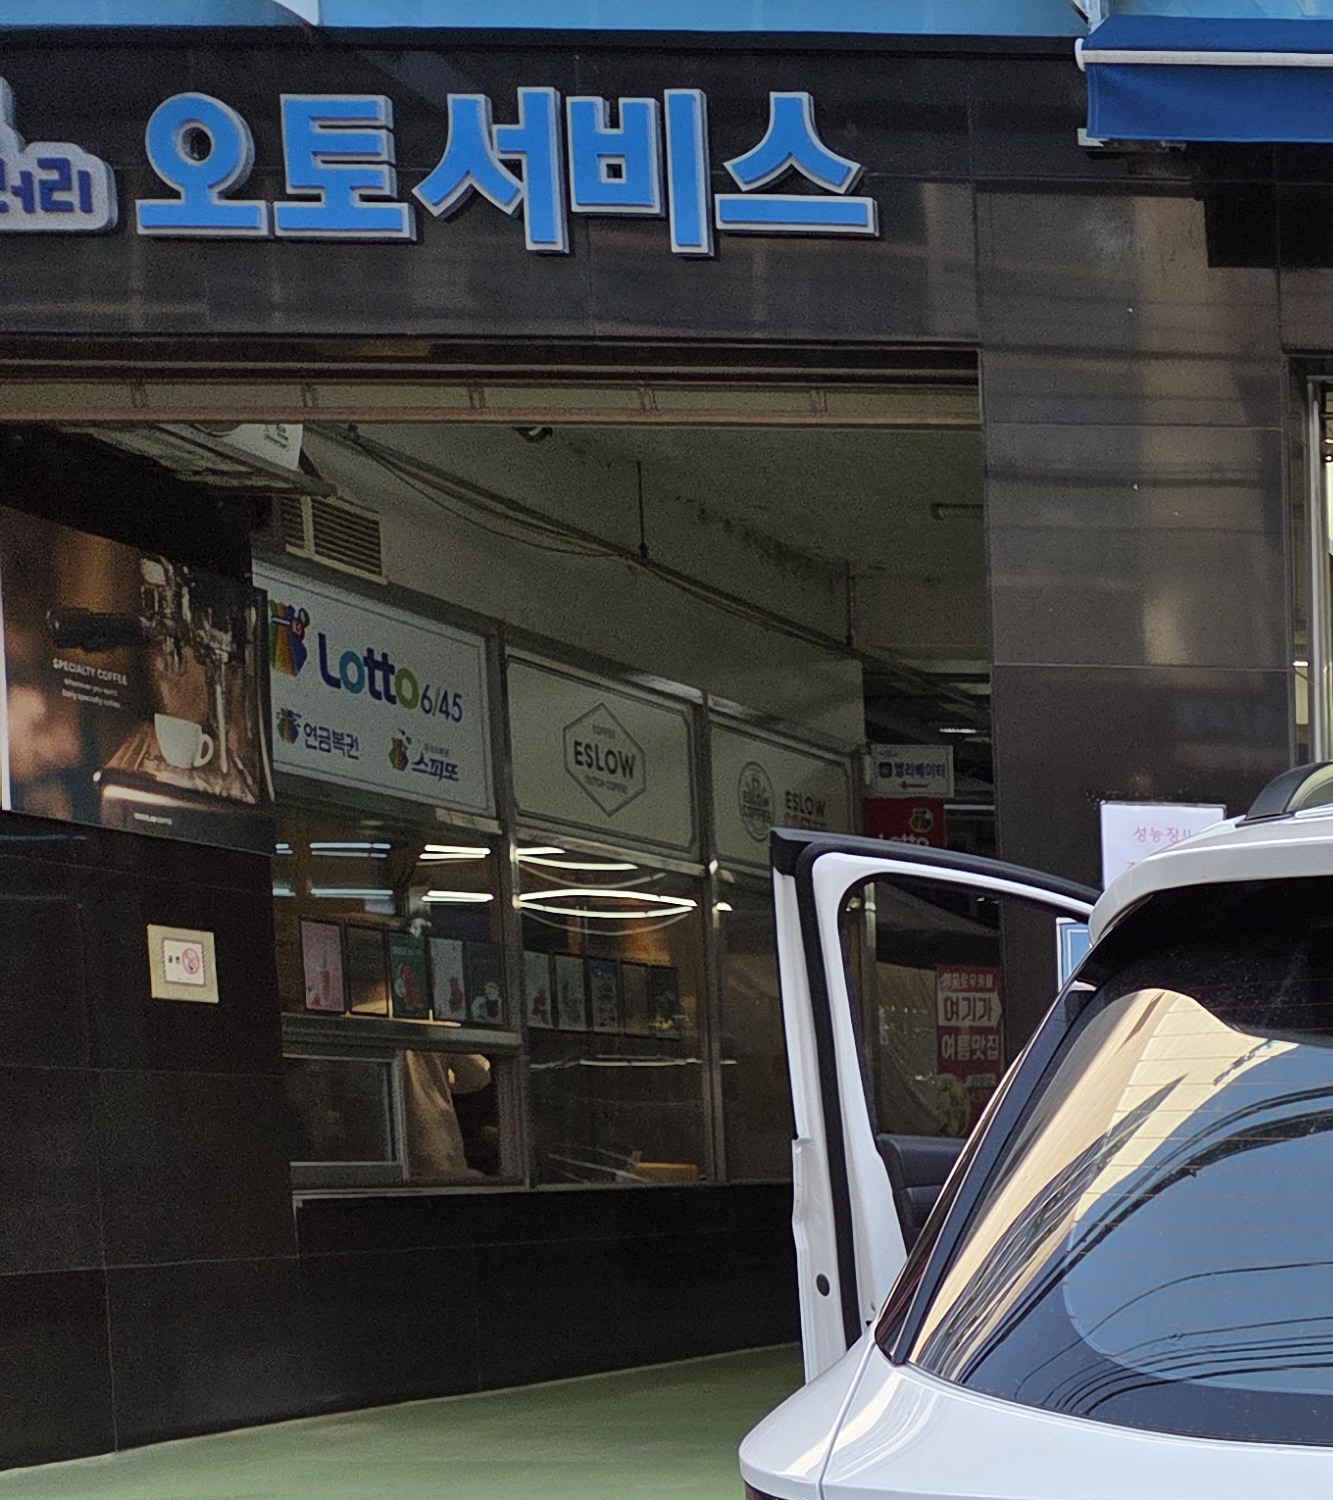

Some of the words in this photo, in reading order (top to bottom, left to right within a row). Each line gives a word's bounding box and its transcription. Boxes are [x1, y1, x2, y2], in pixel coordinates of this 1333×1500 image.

[137, 86, 878, 255] 오토서비스
[318, 632, 420, 711] Lotto
[420, 684, 463, 723] 6/45
[303, 722, 359, 760] 연금복권
[574, 740, 636, 779] ESLOW
[785, 791, 827, 817] ESLOW
